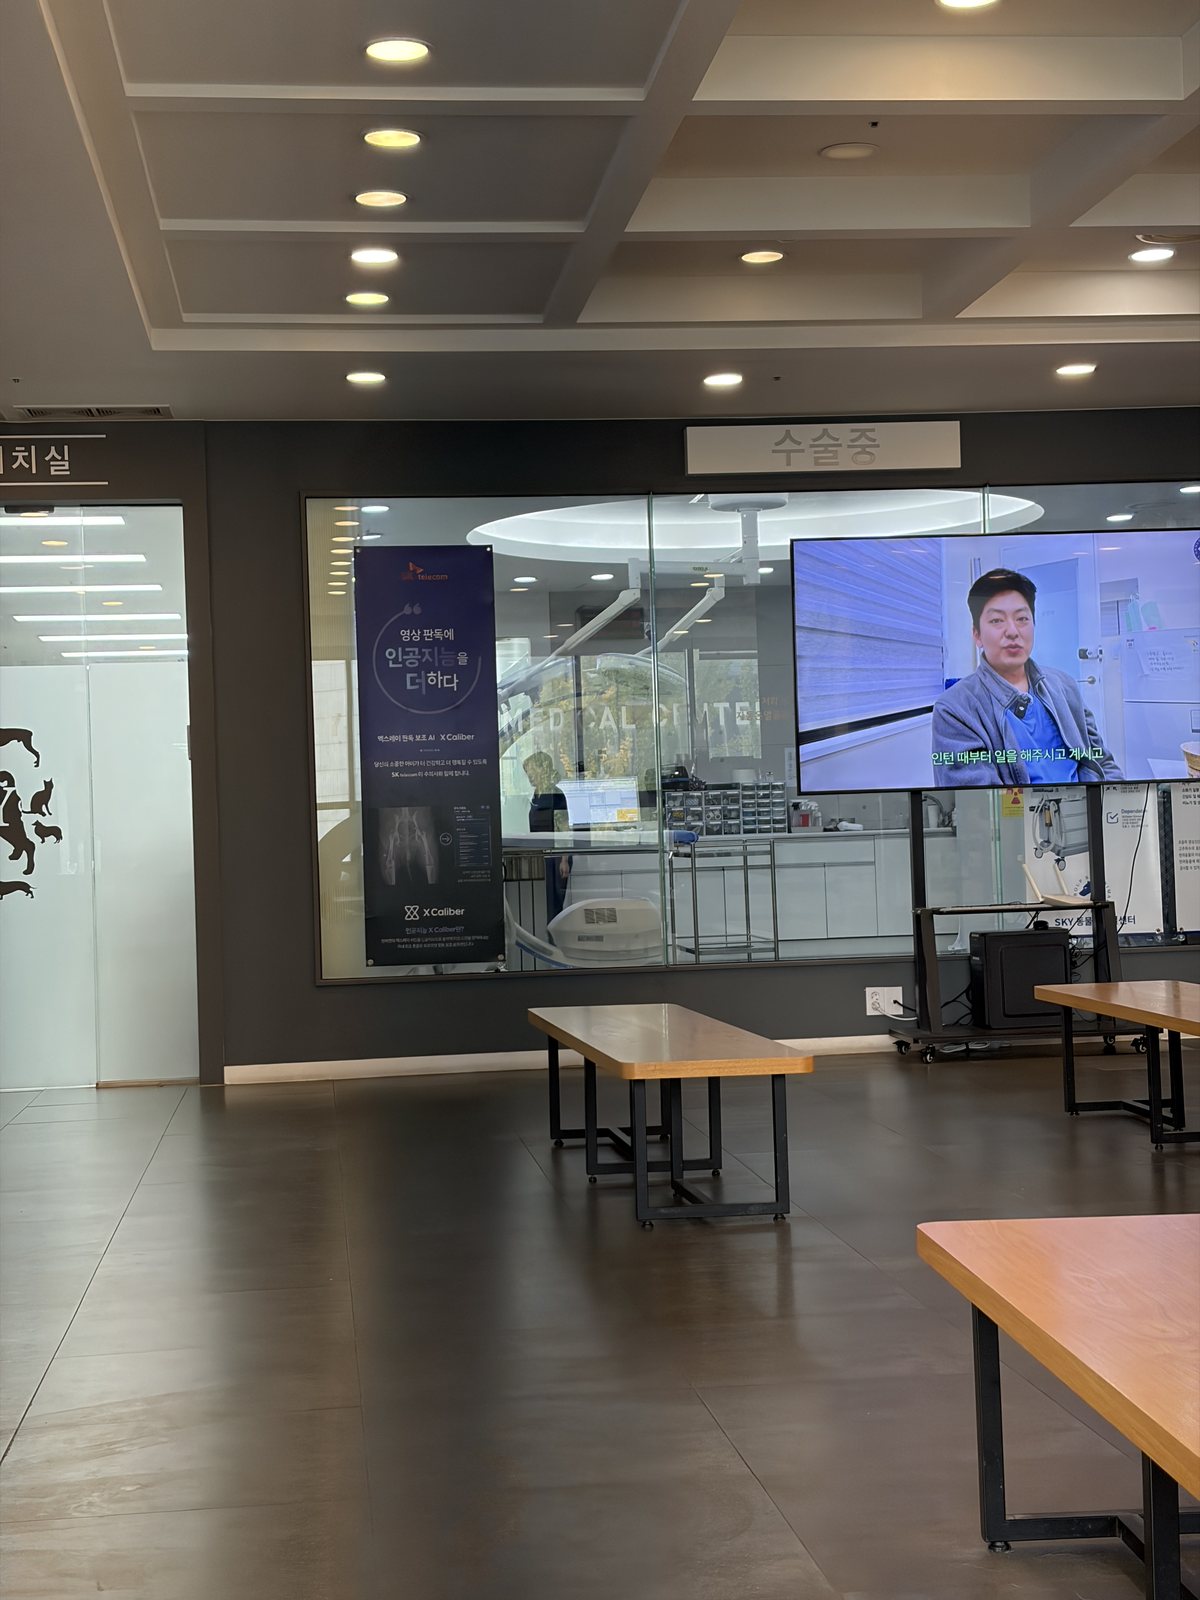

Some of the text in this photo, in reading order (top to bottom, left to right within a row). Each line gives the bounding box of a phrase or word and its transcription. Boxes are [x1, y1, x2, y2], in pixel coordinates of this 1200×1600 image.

[771, 428, 881, 467] 수술중
[0, 445, 71, 476] 치실
[400, 628, 454, 642] 영상 판독에
[385, 646, 469, 668] 인공지능을
[406, 670, 459, 695] 더하다
[415, 734, 427, 742] 보조
[931, 747, 1104, 766] 인턴 때부터 일을 해주시고 계시고
[1054, 918, 1074, 926] SKY
